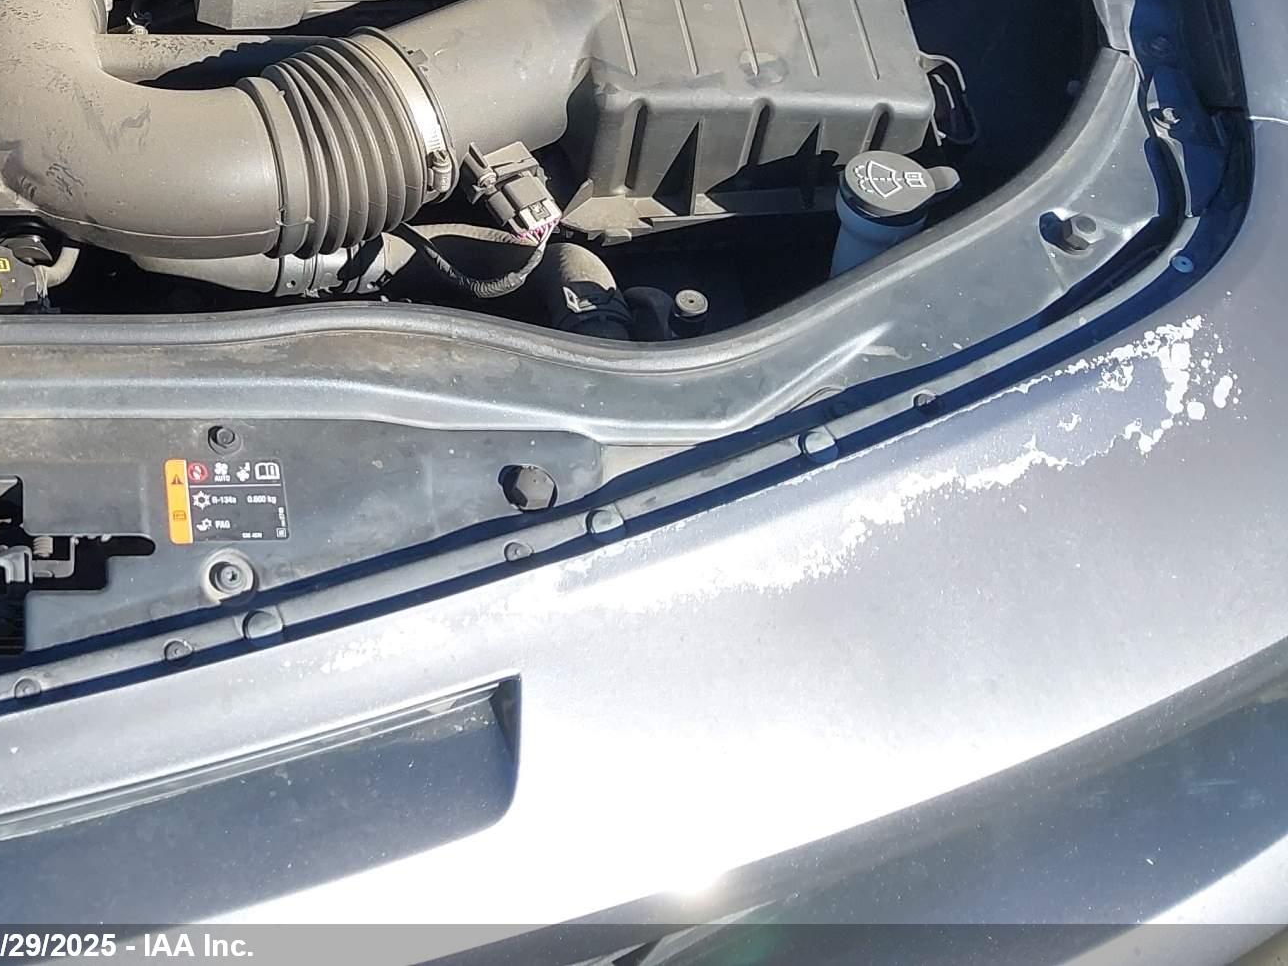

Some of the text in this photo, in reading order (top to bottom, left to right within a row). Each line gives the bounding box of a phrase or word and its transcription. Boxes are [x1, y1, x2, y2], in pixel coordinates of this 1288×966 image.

[211, 496, 237, 504] R-134a
[267, 495, 277, 504] kg
[214, 520, 231, 529] PAG
